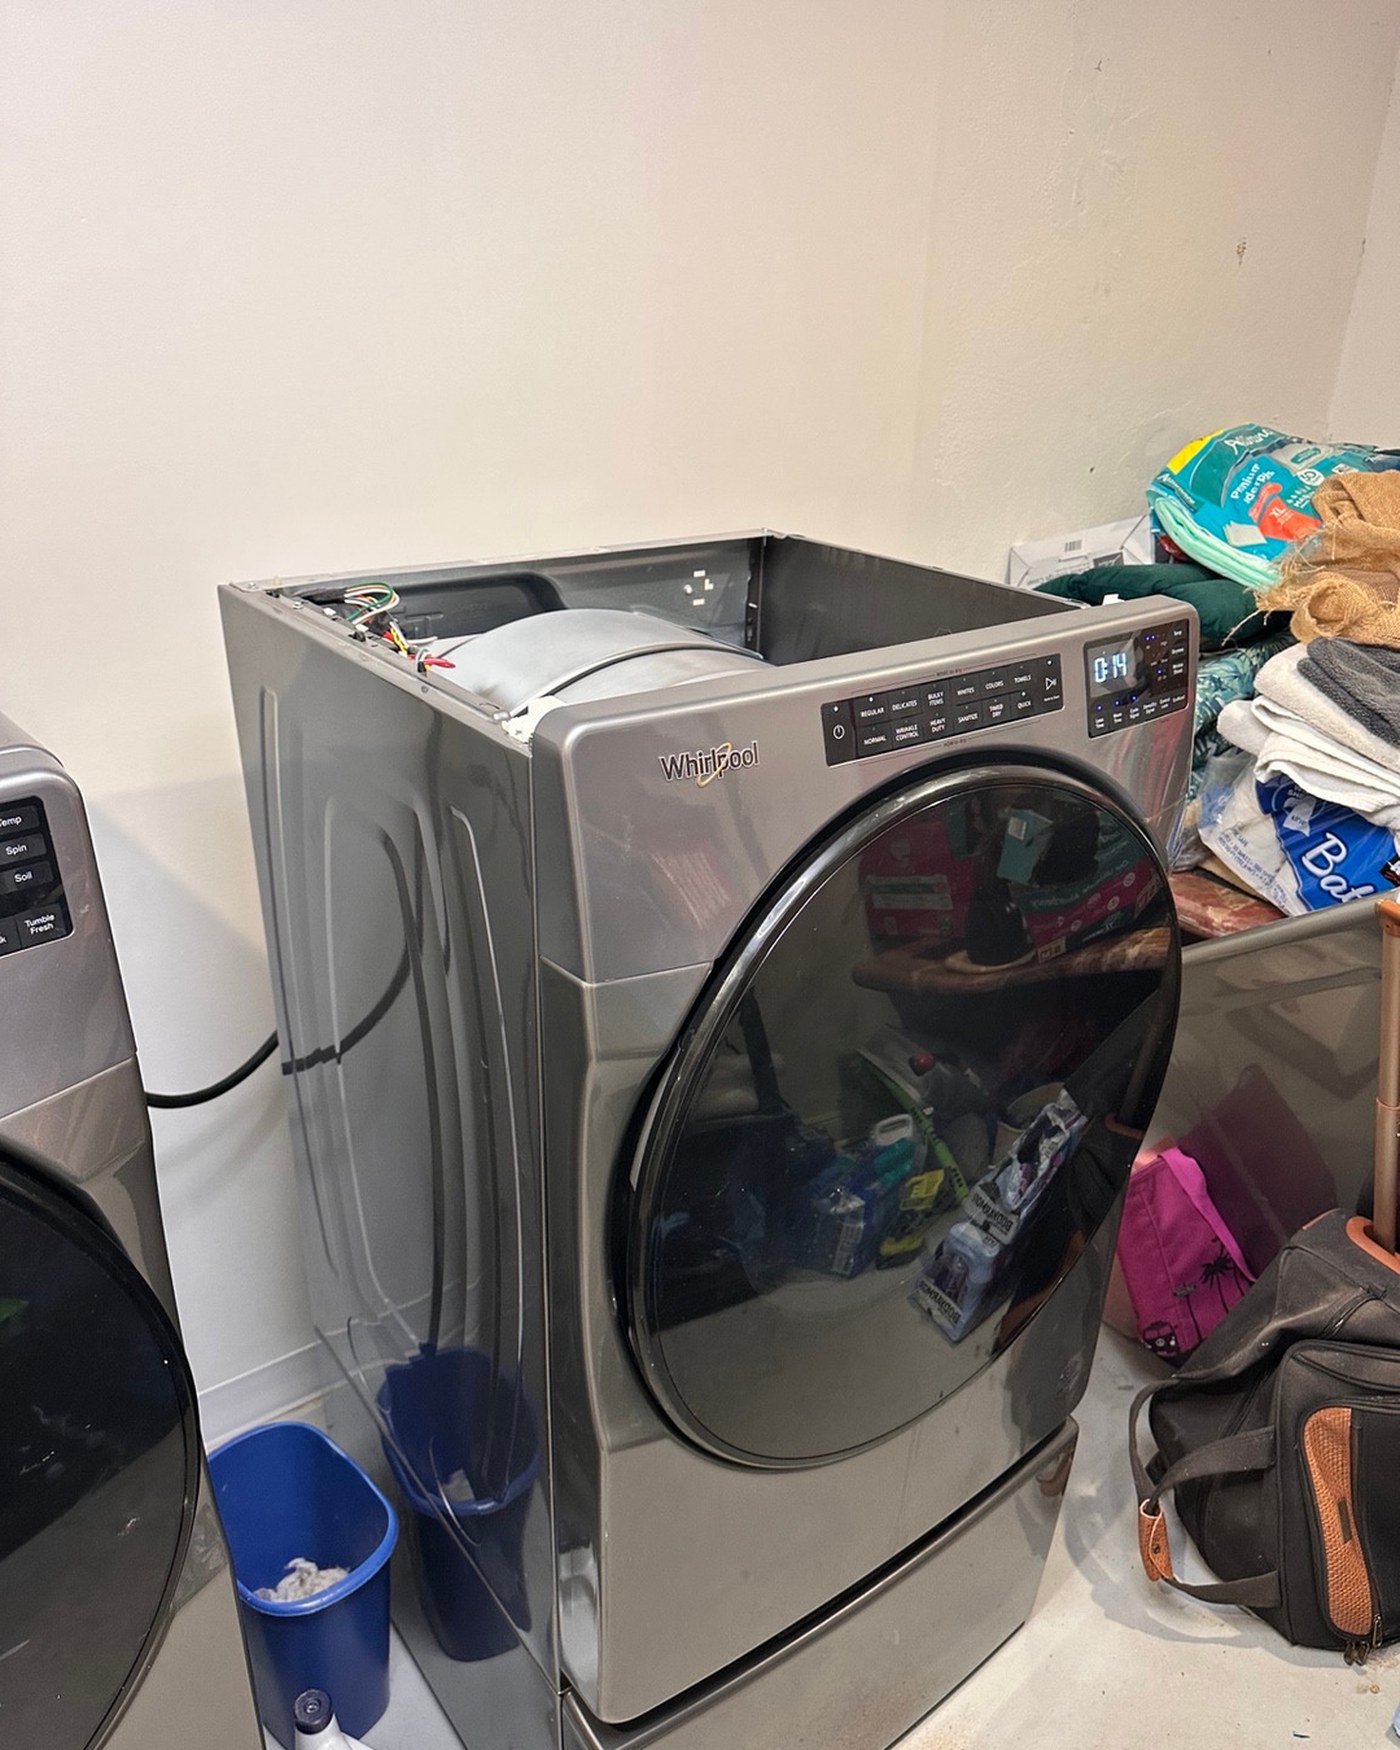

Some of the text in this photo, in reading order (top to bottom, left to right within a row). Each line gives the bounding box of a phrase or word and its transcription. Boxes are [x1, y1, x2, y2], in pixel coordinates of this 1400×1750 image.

[984, 680, 1004, 690] COLORS
[892, 700, 918, 711] DELICATES
[1017, 700, 1031, 710] QUICK
[861, 707, 885, 718] REGULAR
[864, 735, 886, 746] NORMAL
[659, 740, 760, 783] Whirlpool
[5, 844, 28, 856] Spin
[14, 871, 33, 883] Soil
[24, 914, 56, 928] Tumble
[30, 923, 54, 935] Fresh
